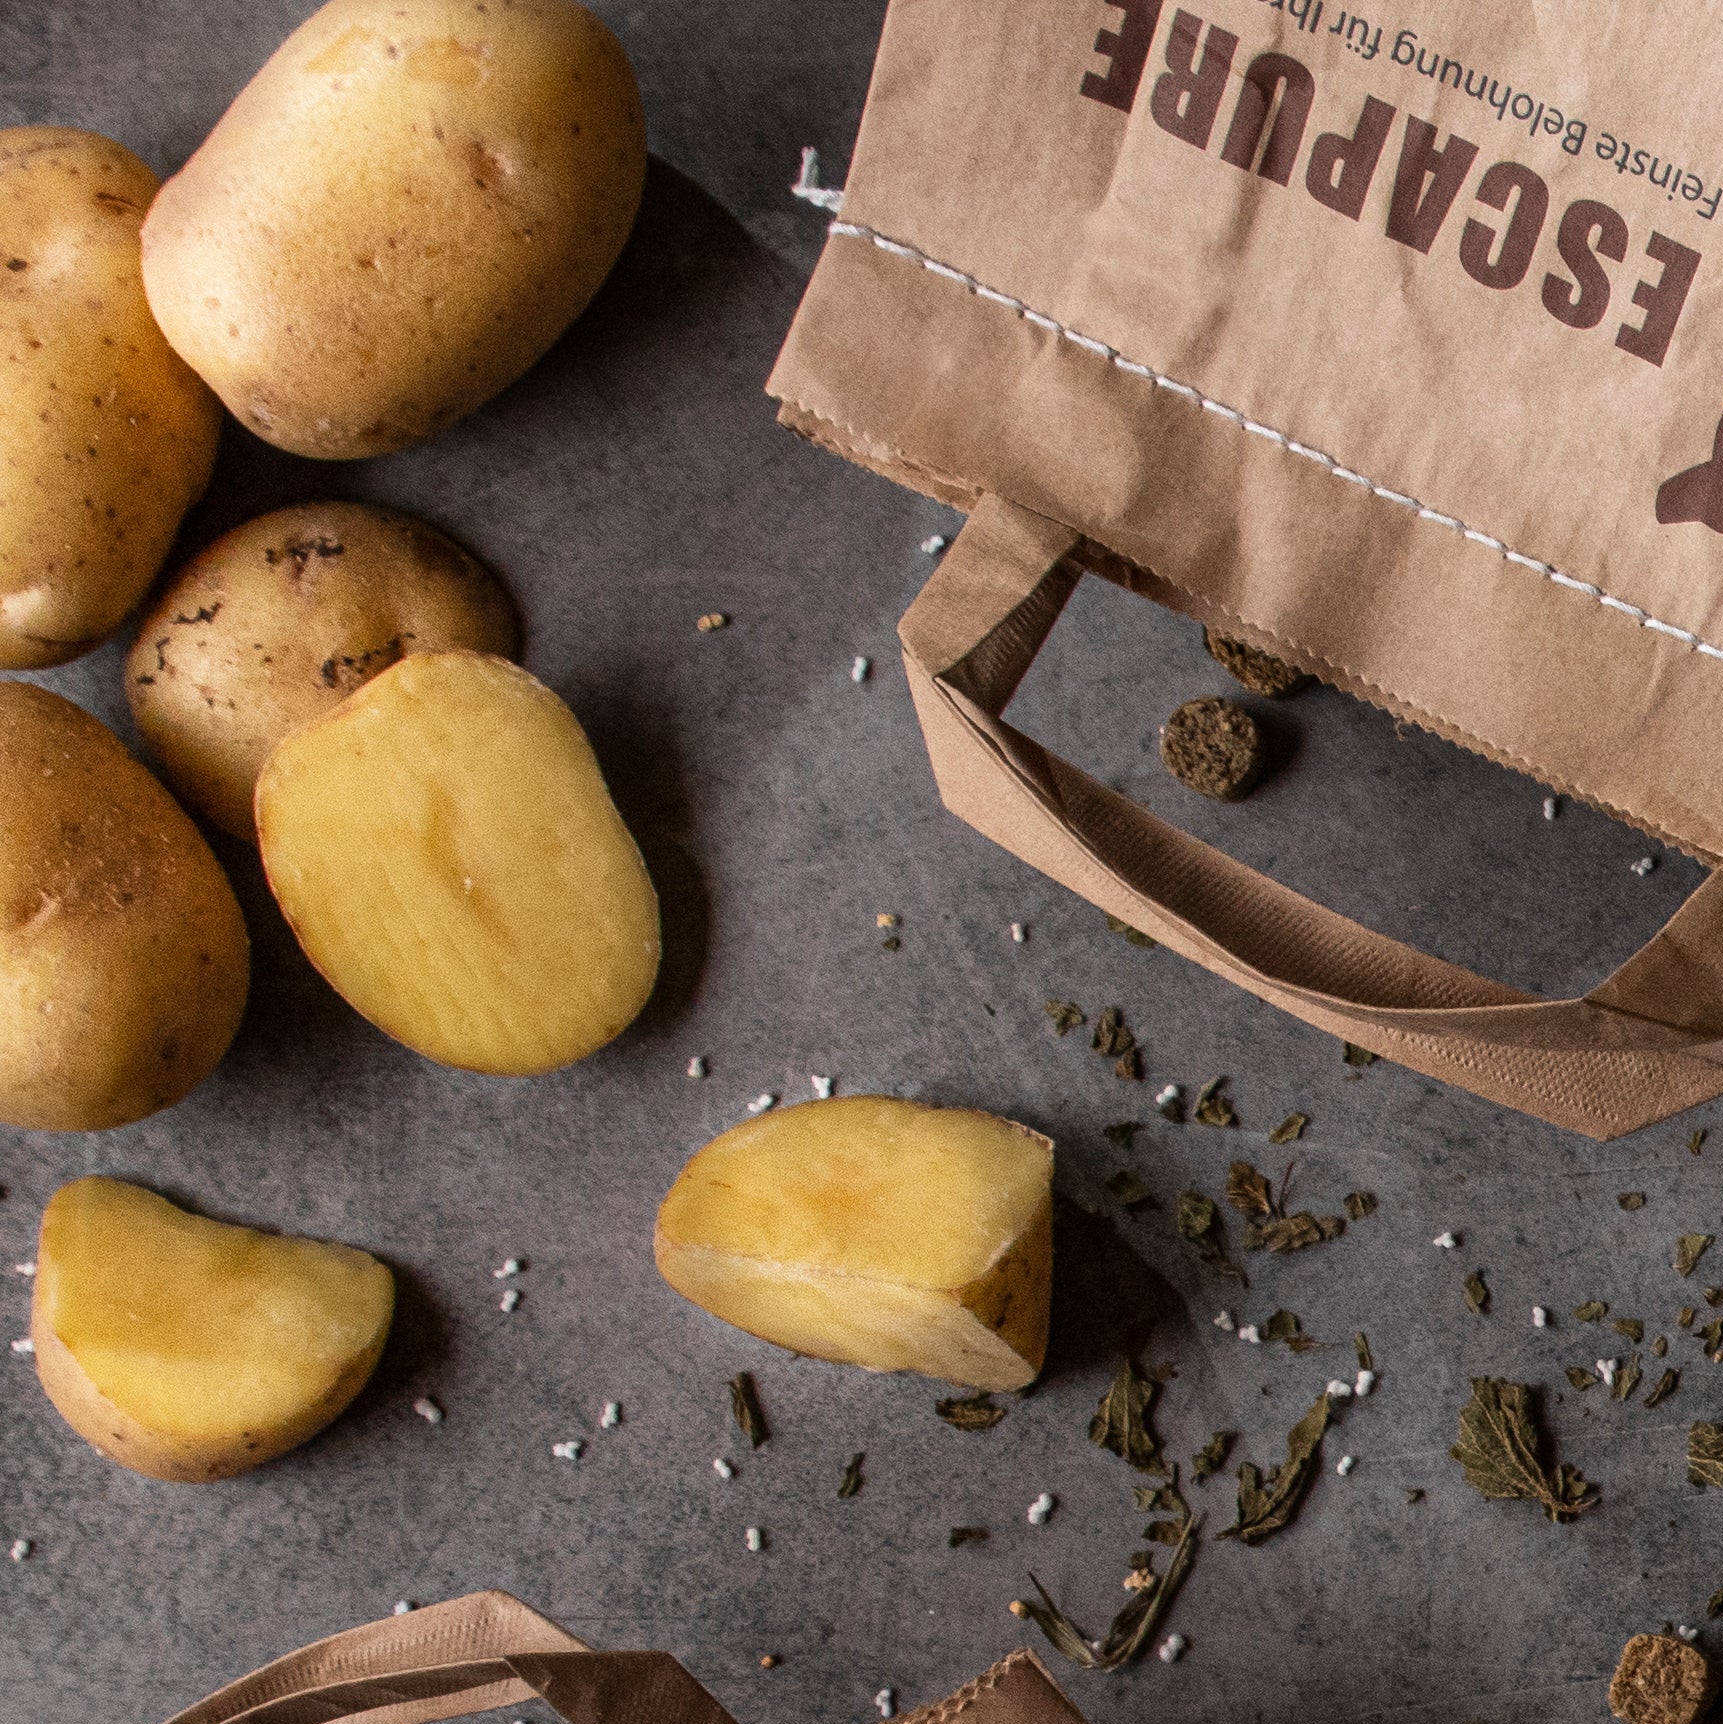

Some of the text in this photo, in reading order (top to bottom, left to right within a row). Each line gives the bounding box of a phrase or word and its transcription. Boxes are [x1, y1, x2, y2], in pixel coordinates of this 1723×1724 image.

[1329, 11, 1382, 60] für
[1390, 29, 1587, 156] Belohnung
[1079, 0, 1702, 368] ESCAPURE
[1595, 131, 1723, 221] Feinste
